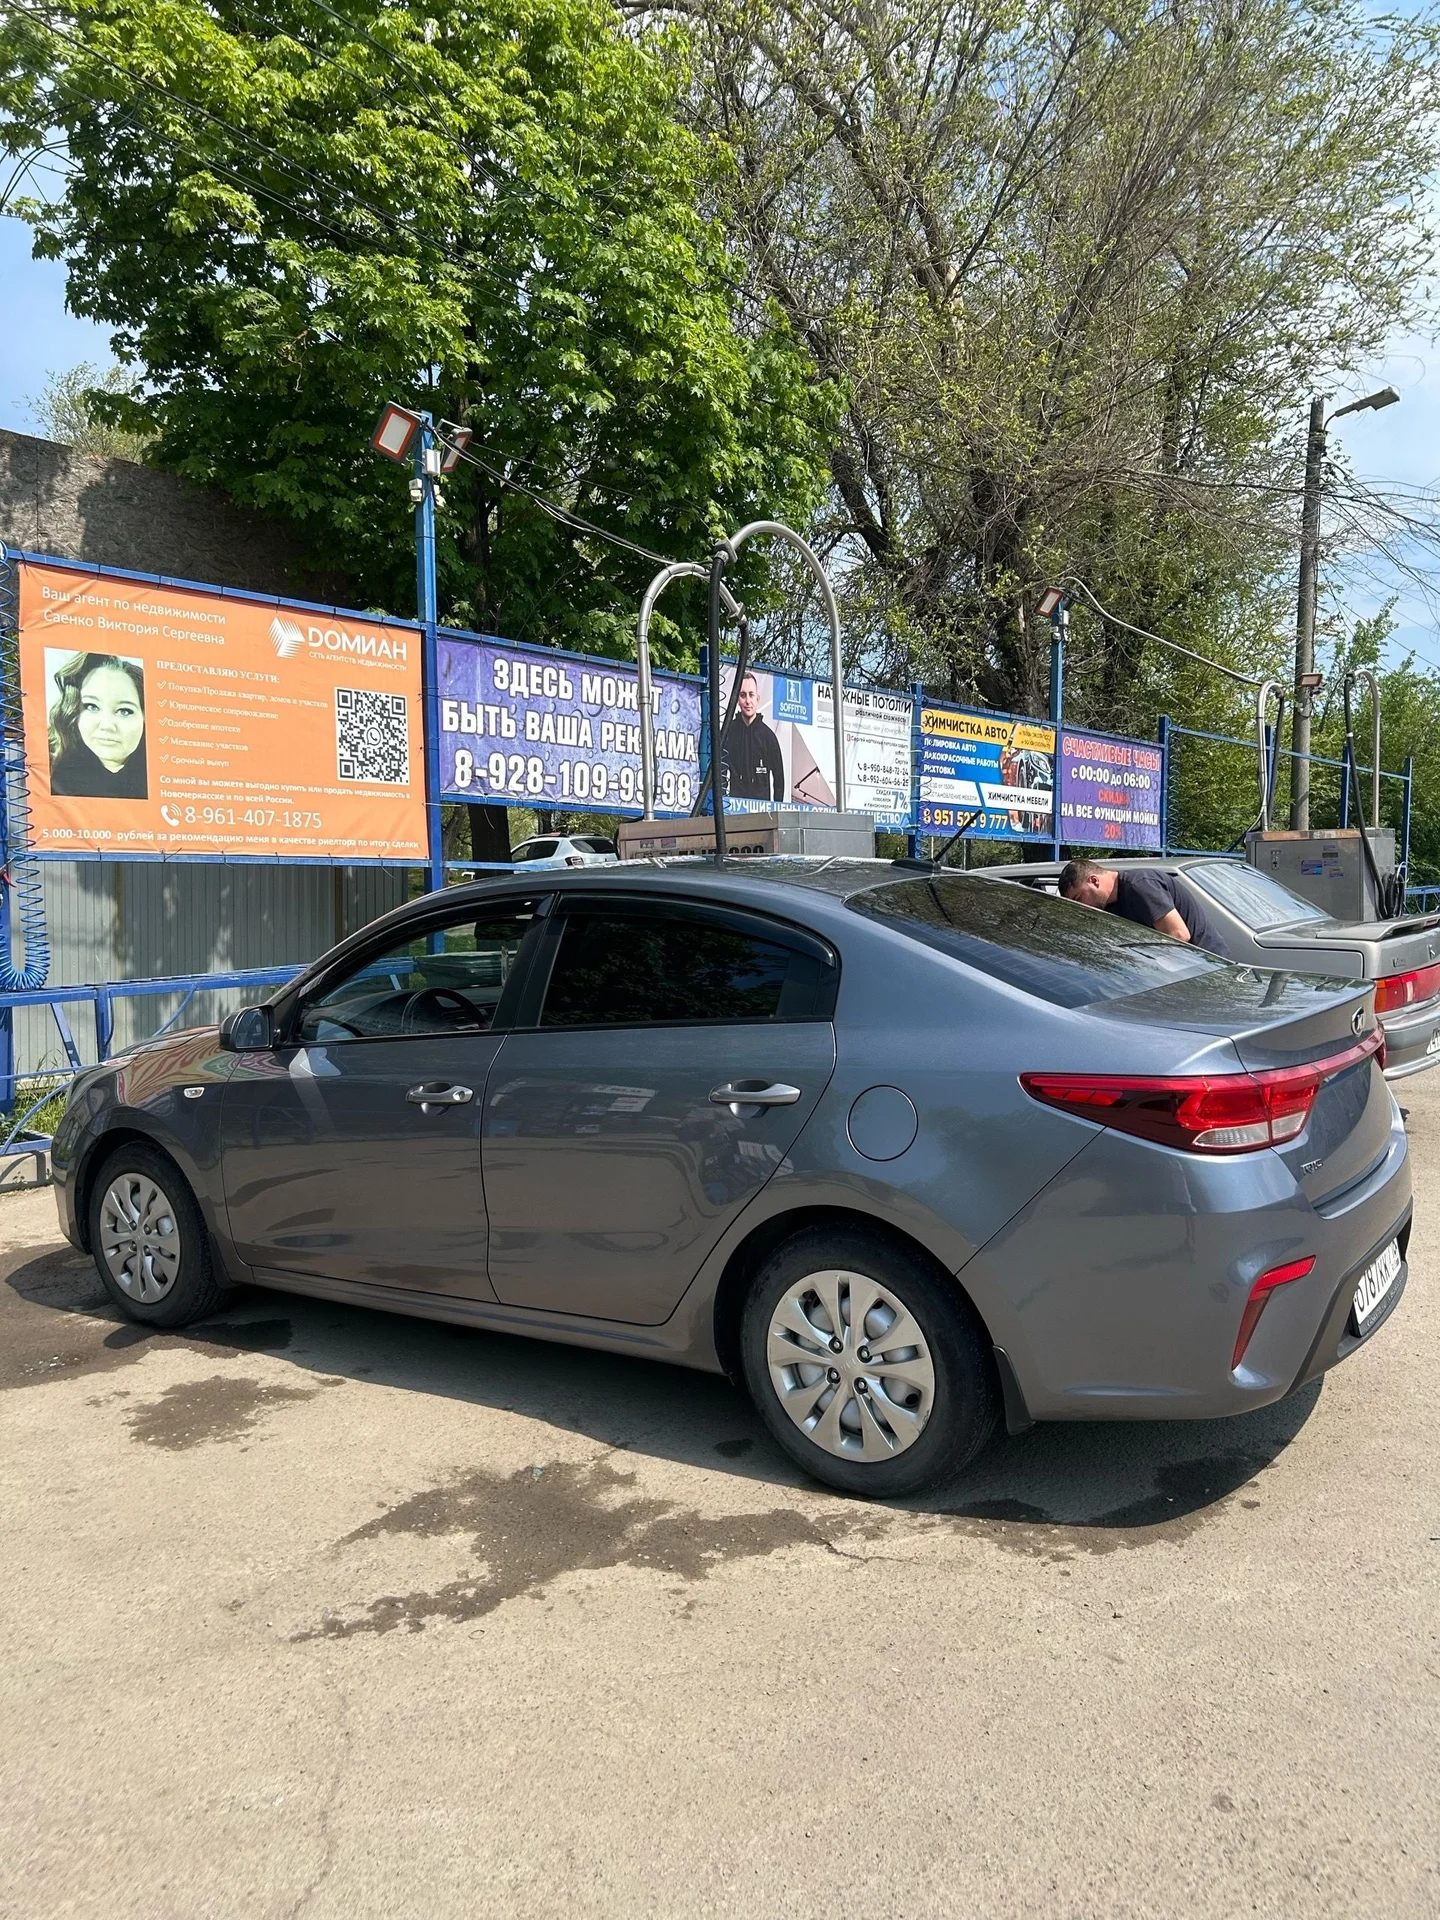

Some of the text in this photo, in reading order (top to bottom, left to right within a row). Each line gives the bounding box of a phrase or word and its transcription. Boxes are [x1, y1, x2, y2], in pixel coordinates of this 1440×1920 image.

[42, 586, 226, 625] Ваш агент по недвижимости
[43, 609, 225, 645] Саенко Виктория Сергеевна
[309, 651, 326, 660] СЕТЬ
[156, 660, 281, 684] ПРЕДОСТАВЛЯЮ УСЛУГИ:
[168, 682, 237, 698] Покупка/Продажа
[238, 691, 269, 703] квартир,
[270, 696, 292, 705] домов
[298, 699, 328, 709] участков
[492, 657, 663, 715] ЗДЕСЬ МОЖТ
[169, 701, 279, 720] Юридическое сопровождение
[779, 701, 807, 715] SOFFITTO
[167, 719, 241, 734] Одобрение ипотеки
[442, 699, 699, 762] БЫТЬ ВАША РЕКАМА
[924, 715, 983, 736] ХИМЧИСТКА
[984, 726, 1008, 740] АВТО
[215, 742, 249, 752] участков
[961, 743, 977, 753] АВТО
[1062, 736, 1132, 767] СЧАСТЛИВЫЕ
[1133, 749, 1160, 771] ЧАСЫ
[171, 756, 230, 769] Срочный выкуп
[976, 758, 999, 769] РАБОТЫ
[159, 775, 171, 784] Со
[173, 776, 196, 786] мной
[198, 779, 210, 787] вы
[212, 780, 244, 789] можете
[246, 782, 280, 792] выгодно
[281, 784, 307, 795] купить
[324, 788, 353, 797] продать
[354, 789, 405, 799] недвижимость
[1071, 765, 1151, 790] с 00:00 до 06:00
[160, 789, 225, 802] Новочеркасске
[245, 795, 264, 803] всей
[265, 795, 295, 805] России.
[892, 791, 909, 811] 7%
[987, 791, 1049, 807] ХИМЧИСТКА МЕБЕЛИ
[185, 805, 323, 829] 8-961-407-1875
[934, 809, 954, 826] 951
[979, 813, 987, 829] 9
[989, 814, 1009, 830] 777
[1061, 802, 1158, 826] НА ВСЕ ФУНКЦИИ МОЙКИ
[42, 828, 112, 840] 5.000-10.000
[117, 829, 154, 842] рублей
[156, 833, 168, 841] за
[169, 833, 244, 845] рекомендацию
[246, 836, 270, 844] меня
[279, 837, 316, 845] качестве
[318, 838, 357, 848] риелтора
[358, 839, 368, 847] по
[369, 840, 390, 849] итогу
[391, 841, 419, 849] сделки
